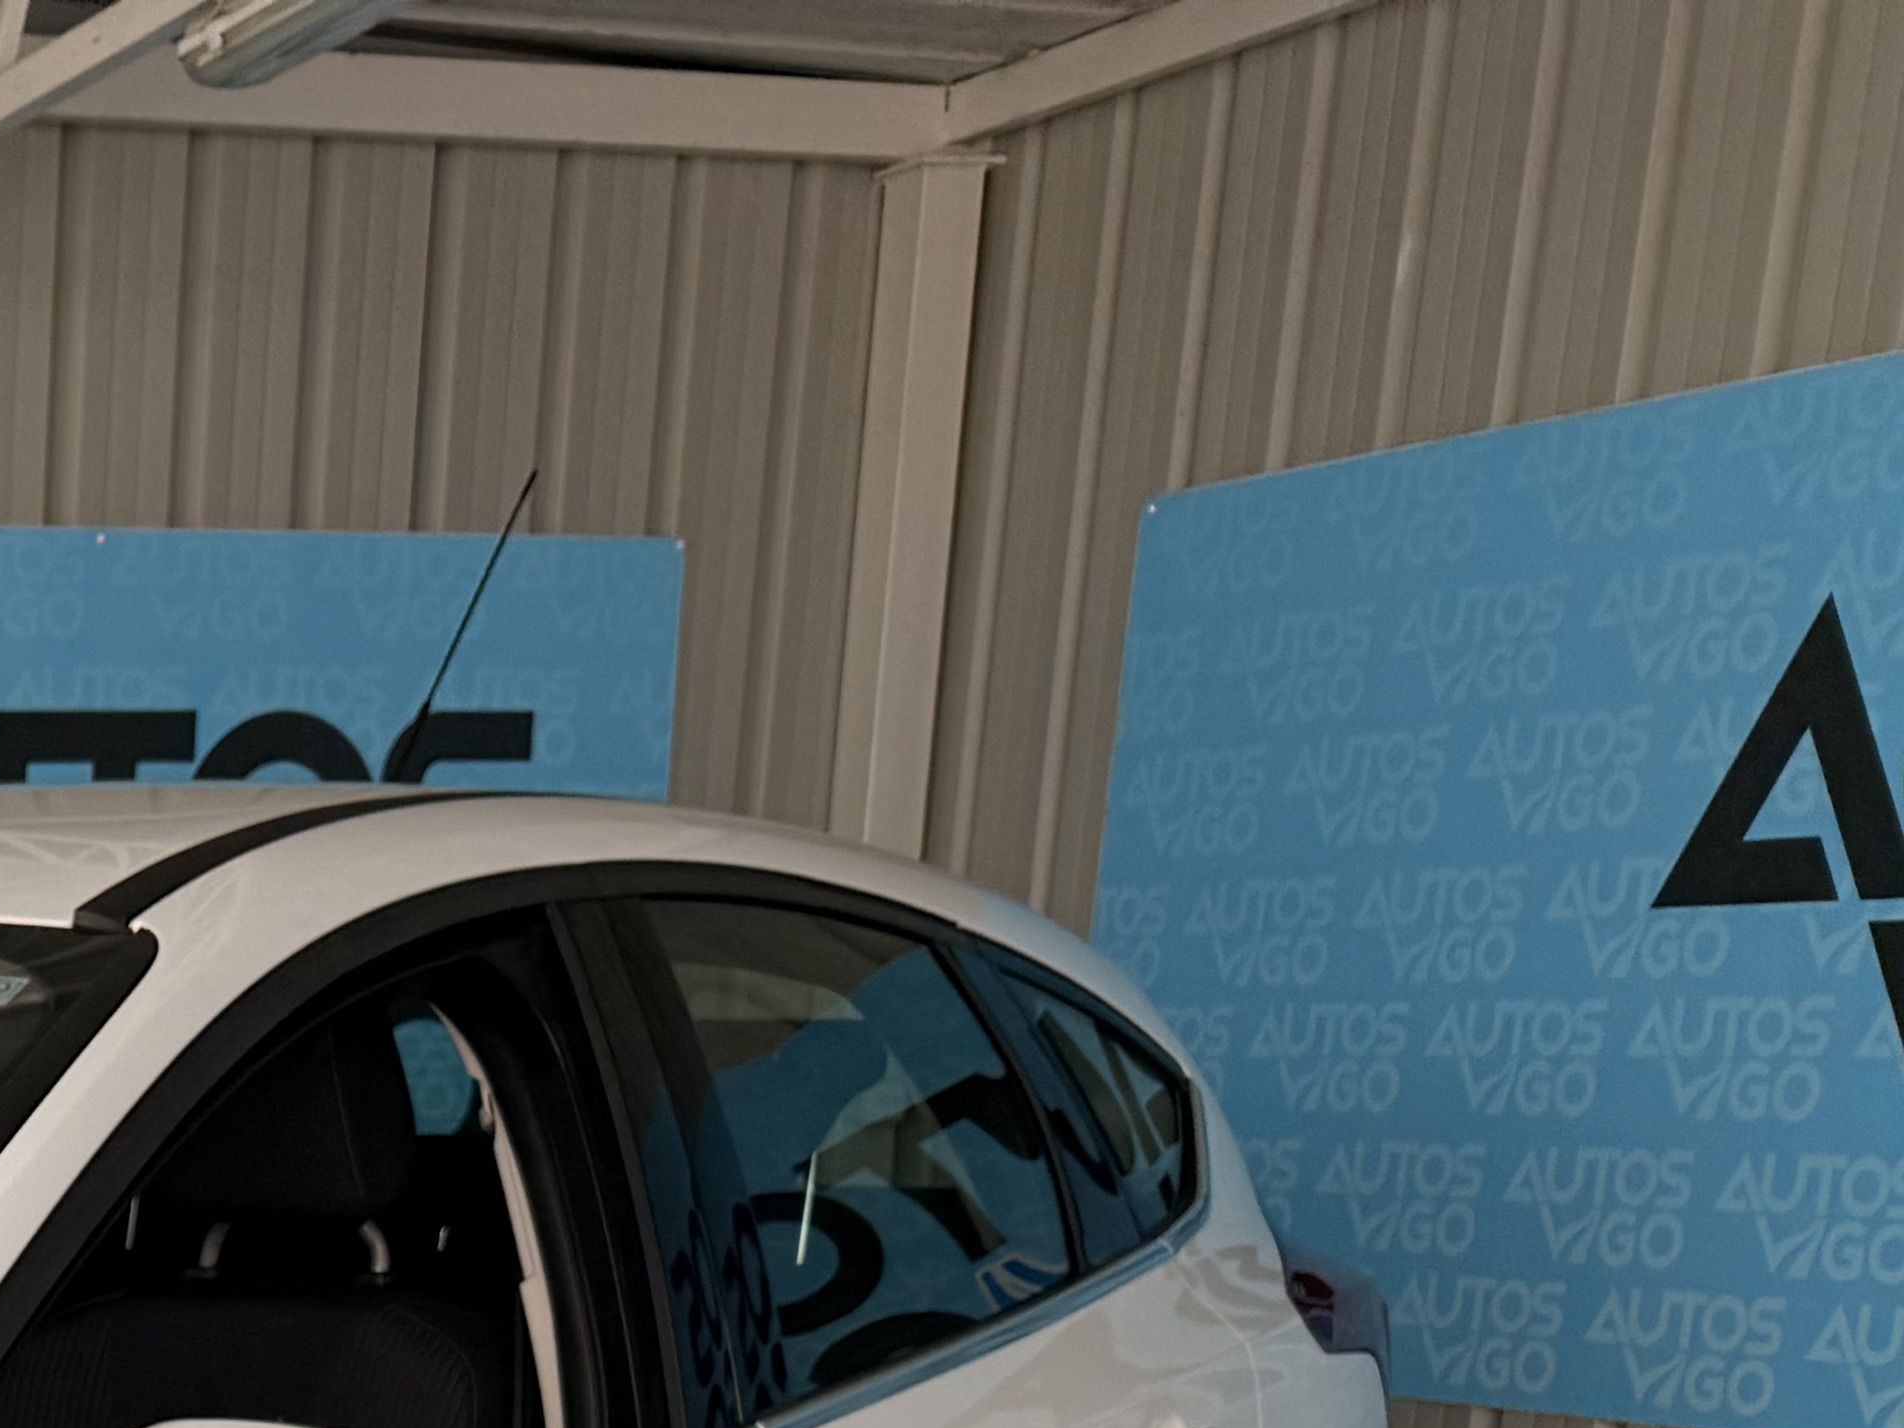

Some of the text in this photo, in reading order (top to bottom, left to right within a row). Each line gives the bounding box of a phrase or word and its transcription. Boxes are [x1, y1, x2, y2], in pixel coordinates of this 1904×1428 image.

[1507, 403, 1699, 490] AUTOS
[111, 537, 287, 587] AUTOS
[1588, 543, 1792, 629] AUTOS
[1217, 603, 1375, 674] AUTOS
[1393, 573, 1571, 655] AUTOS
[1423, 635, 1558, 703] VIGO
[1626, 610, 1780, 684] VIGO
[1247, 663, 1365, 725] VIGO
[1283, 725, 1450, 796] AUTOS
[1466, 703, 1654, 778] AUTOS
[1127, 743, 1267, 808] AUTOS
[1502, 768, 1641, 834] VIGO
[1315, 785, 1438, 847] VIGO
[1184, 875, 1339, 935] AUTOS
[1352, 862, 1529, 929] AUTOS
[1211, 933, 1329, 987] VIGO
[1385, 926, 1516, 984] VIGO
[1582, 915, 1730, 980] VIGO
[1247, 1001, 1409, 1059] AUTOS
[1424, 997, 1609, 1058] AUTOS
[1626, 994, 1836, 1057] AUTOS
[1278, 1058, 1400, 1114] VIGO
[1459, 1057, 1597, 1117] VIGO
[1666, 1058, 1822, 1123] VIGO
[1315, 1139, 1486, 1198] AUTOS
[1502, 1145, 1695, 1209] AUTOS
[1350, 1202, 1475, 1256] VIGO
[1539, 1202, 1685, 1269] VIGO
[1393, 1269, 1568, 1337] AUTOS
[1583, 1286, 1789, 1357] AUTOS
[1422, 1335, 1556, 1393] VIGO
[1624, 1345, 1775, 1416] VIGO
